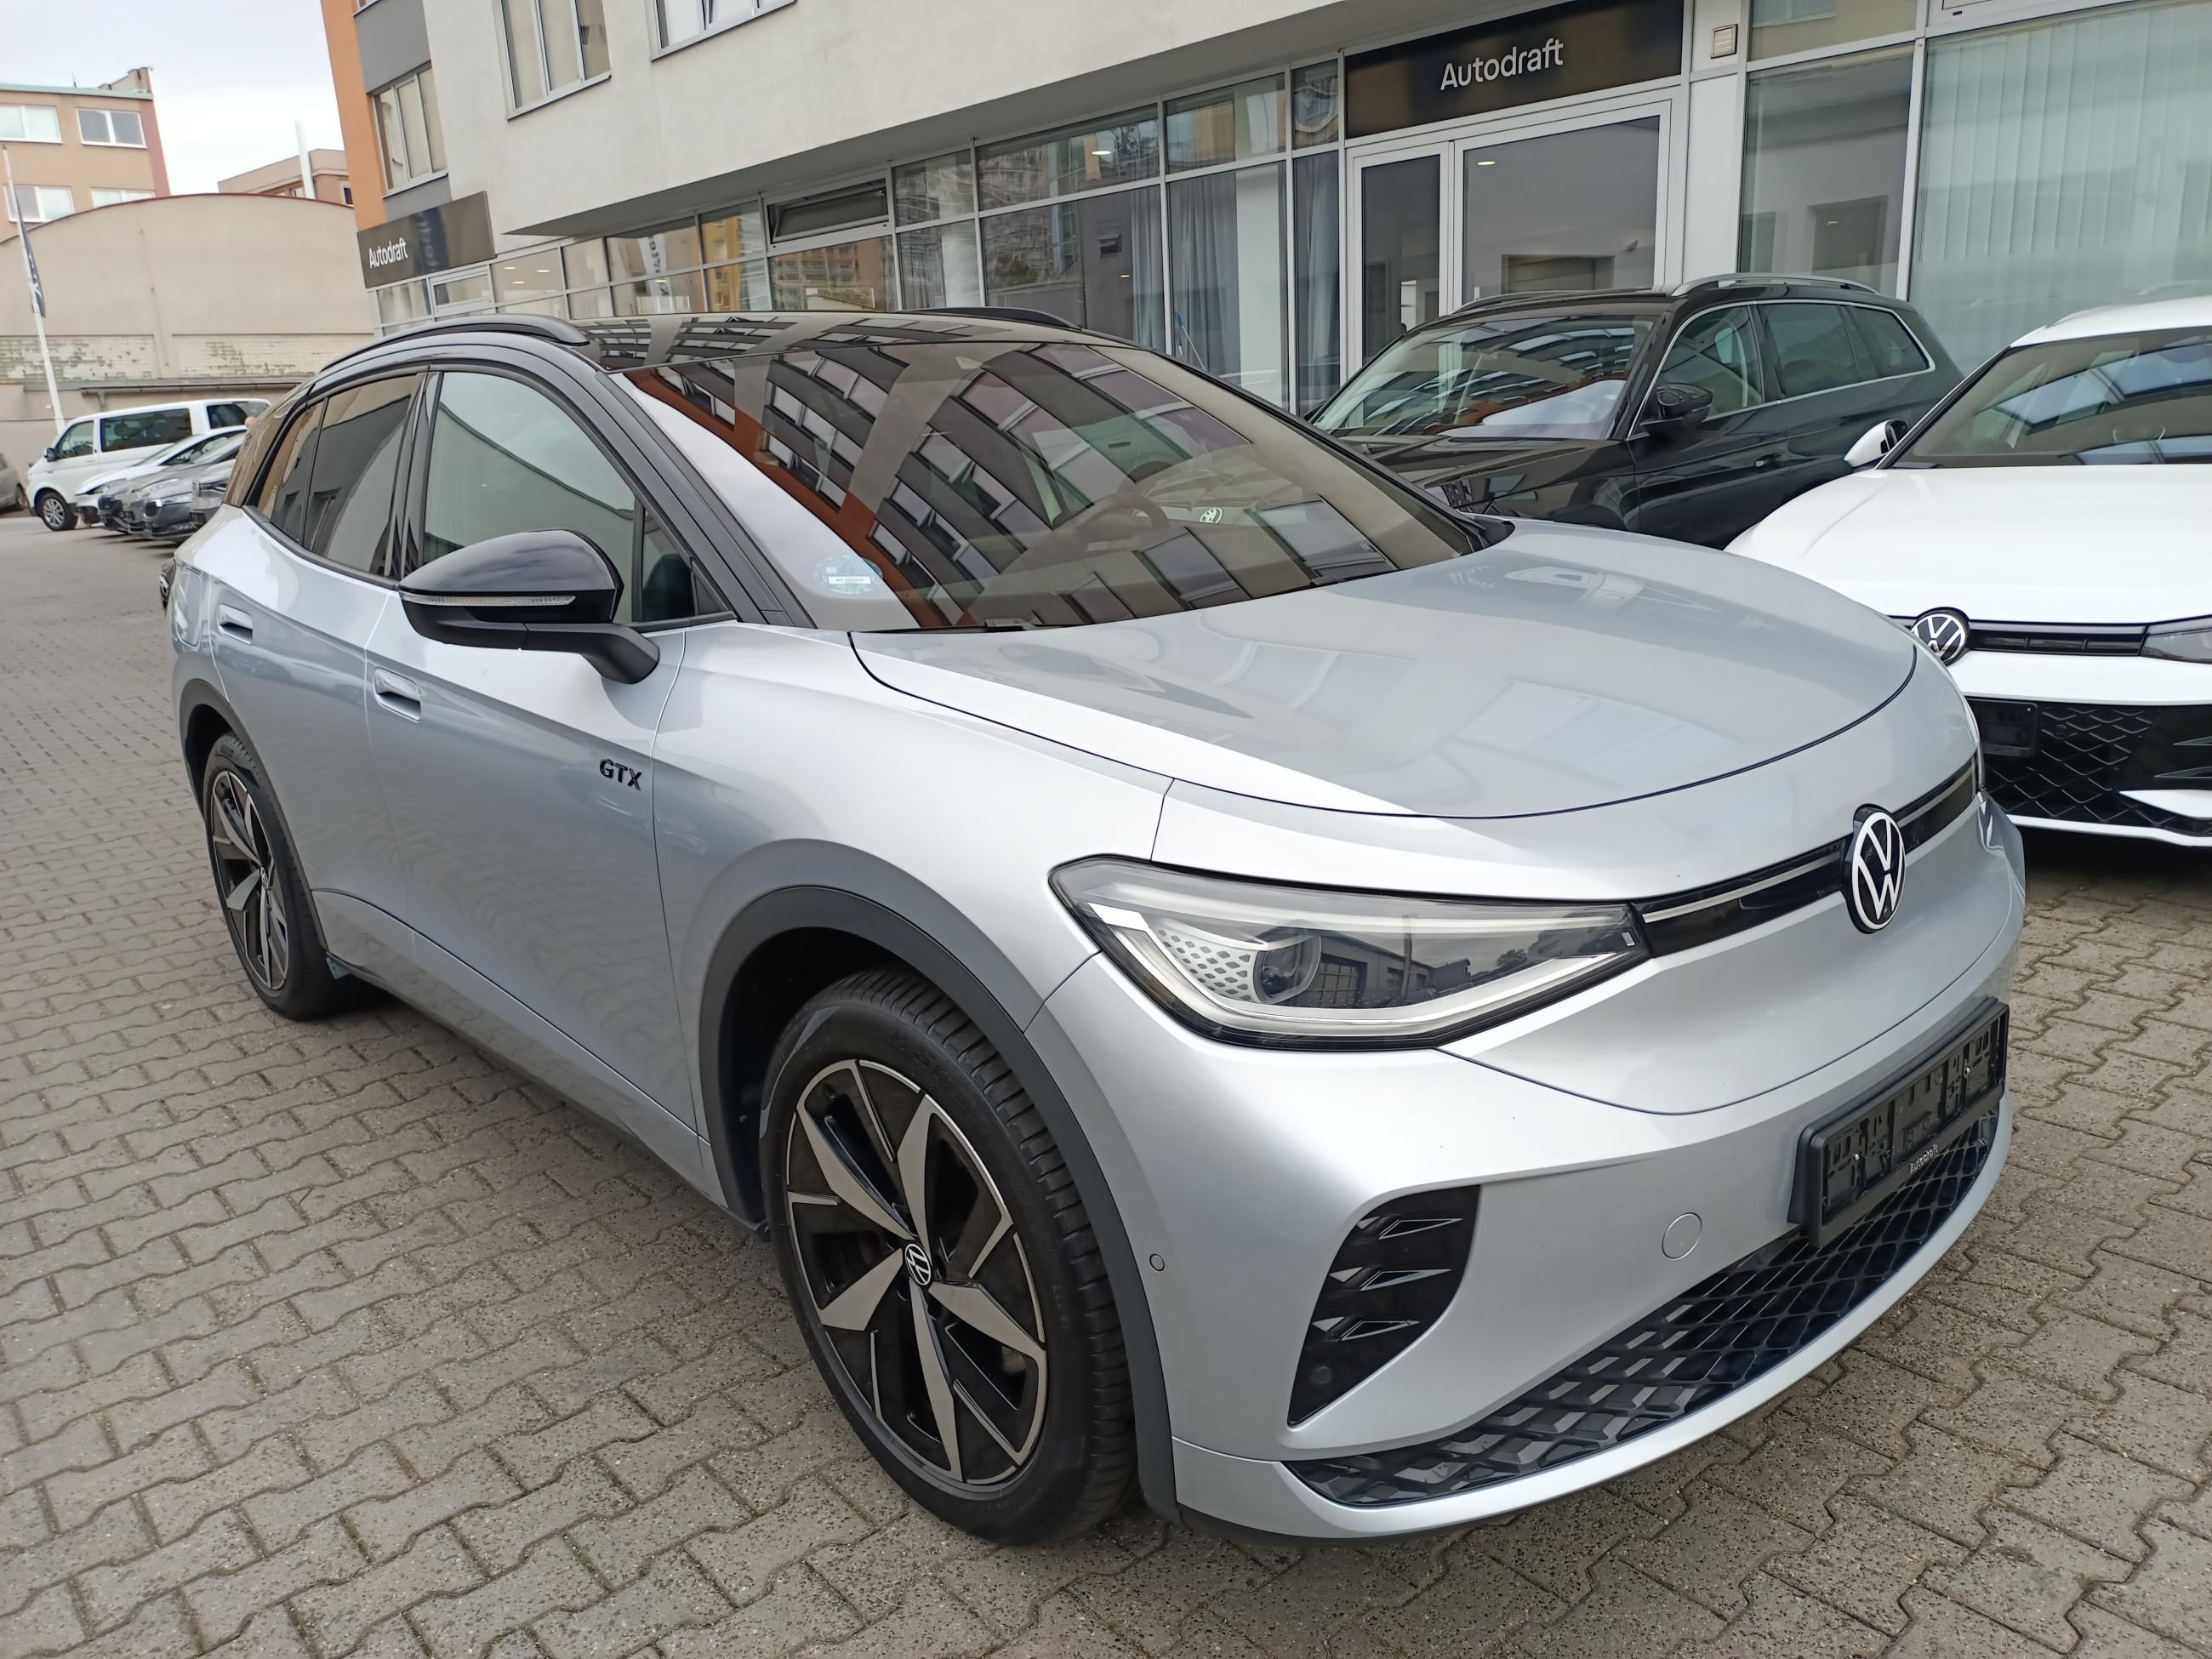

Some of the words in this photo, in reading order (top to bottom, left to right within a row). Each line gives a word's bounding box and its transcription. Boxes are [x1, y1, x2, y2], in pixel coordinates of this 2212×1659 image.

[1440, 37, 1564, 91] Autodraft
[368, 237, 408, 269] Autodraft
[599, 759, 642, 791] GTX
